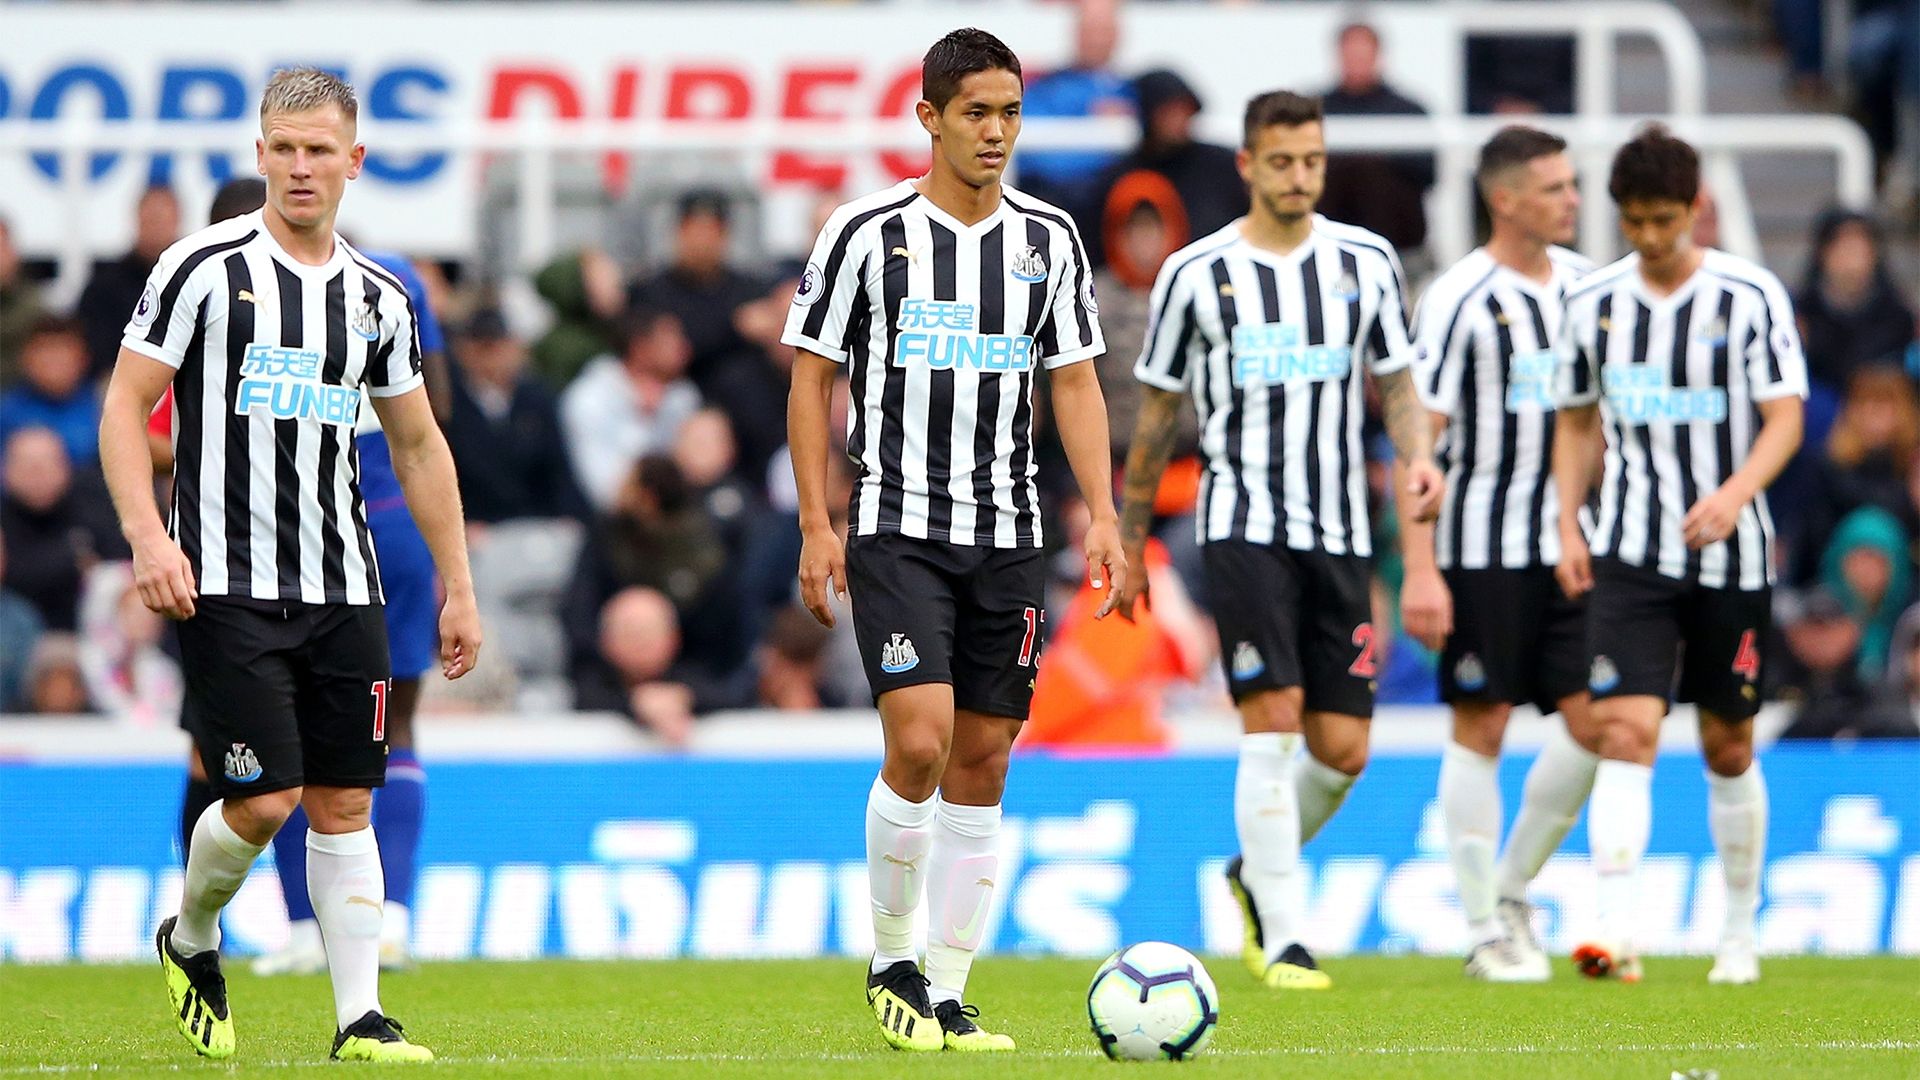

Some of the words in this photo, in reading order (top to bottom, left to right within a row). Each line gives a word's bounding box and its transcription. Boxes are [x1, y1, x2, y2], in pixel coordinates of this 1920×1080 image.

[0, 63, 453, 186] ORS
[899, 299, 974, 331] 乐天堂
[242, 345, 321, 379] 乐天堂
[896, 333, 1033, 370] FUN88
[238, 380, 361, 425] FUN88
[1018, 607, 1045, 670] 1
[1731, 628, 1761, 681] 4
